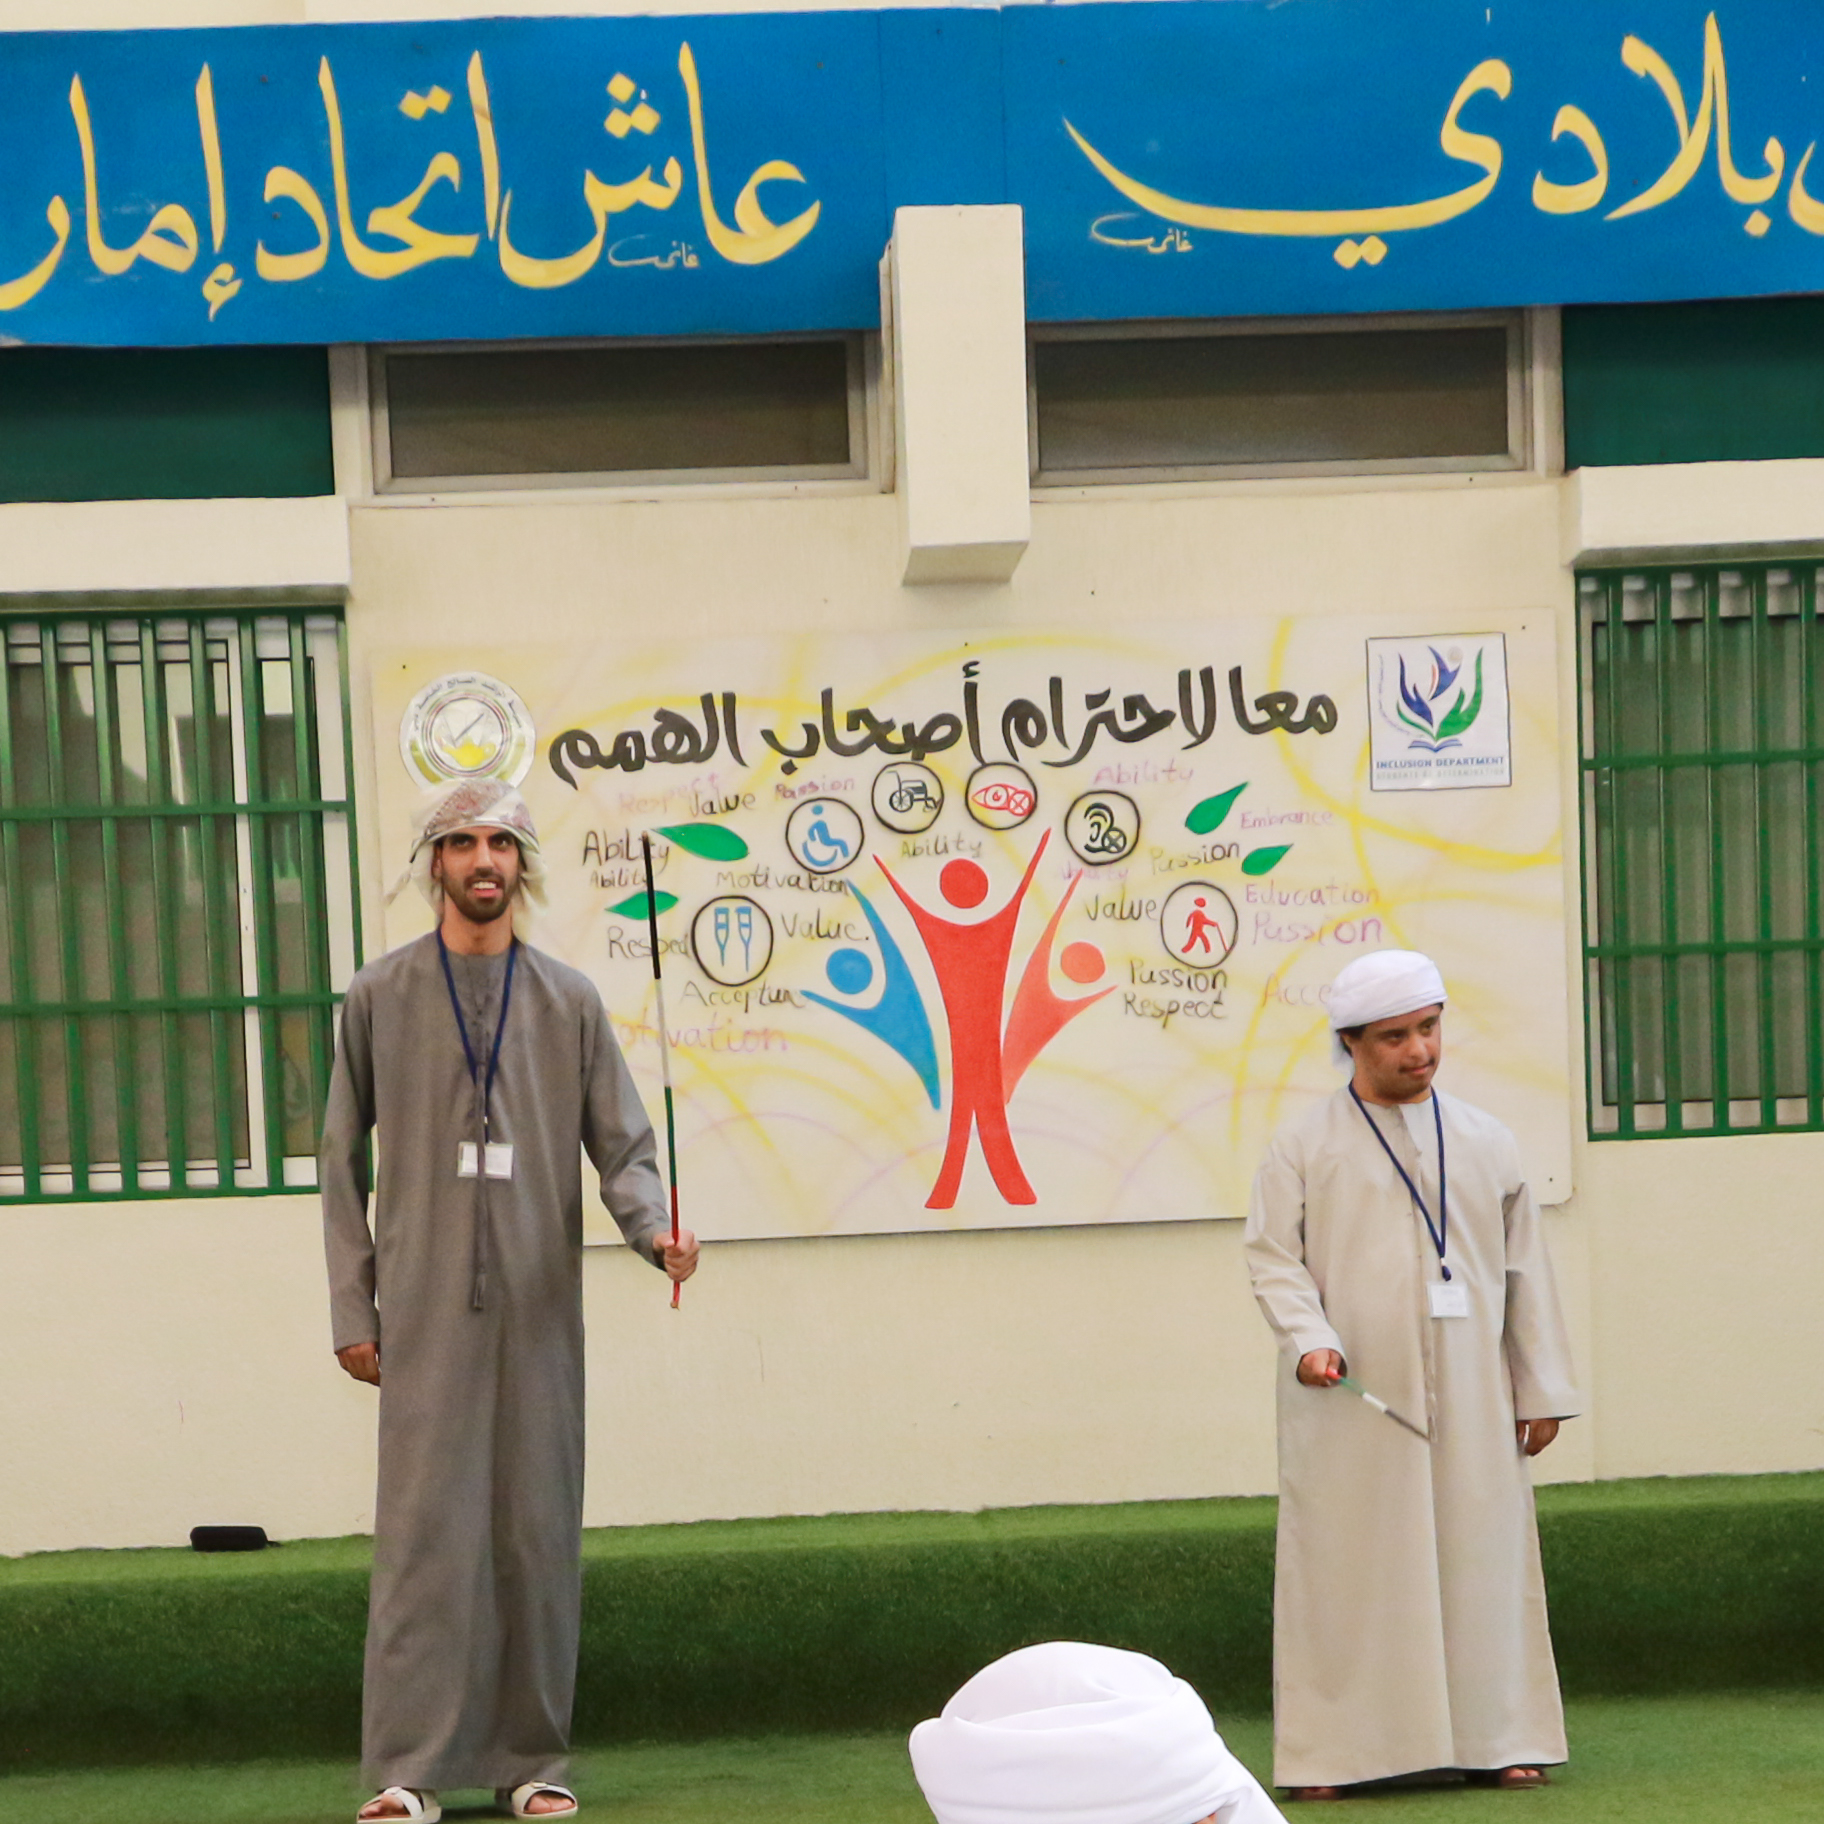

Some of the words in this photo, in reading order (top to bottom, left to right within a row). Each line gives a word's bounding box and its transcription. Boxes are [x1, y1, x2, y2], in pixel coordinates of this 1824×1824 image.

[1063, 14, 1784, 268] بلادي
[257, 53, 499, 280] اتحاد
[499, 44, 821, 288] عاش
[760, 661, 982, 775] أصحاب
[1000, 668, 1217, 768] لاحترام
[1227, 665, 1339, 736] معا
[548, 691, 747, 790] الهمم
[1095, 758, 1194, 784] Ability
[1376, 759, 1432, 769] INCLUSION
[1436, 756, 1504, 767] DEPARTMENT
[689, 787, 756, 818] Value
[776, 775, 855, 799] Passion
[583, 829, 670, 874] Ability
[902, 832, 982, 858] Ability
[717, 863, 850, 896] Motivation
[1246, 877, 1381, 907] Education
[1084, 887, 1157, 922] Value
[1123, 991, 1227, 1028] Respect
[618, 1010, 789, 1052] otivation
